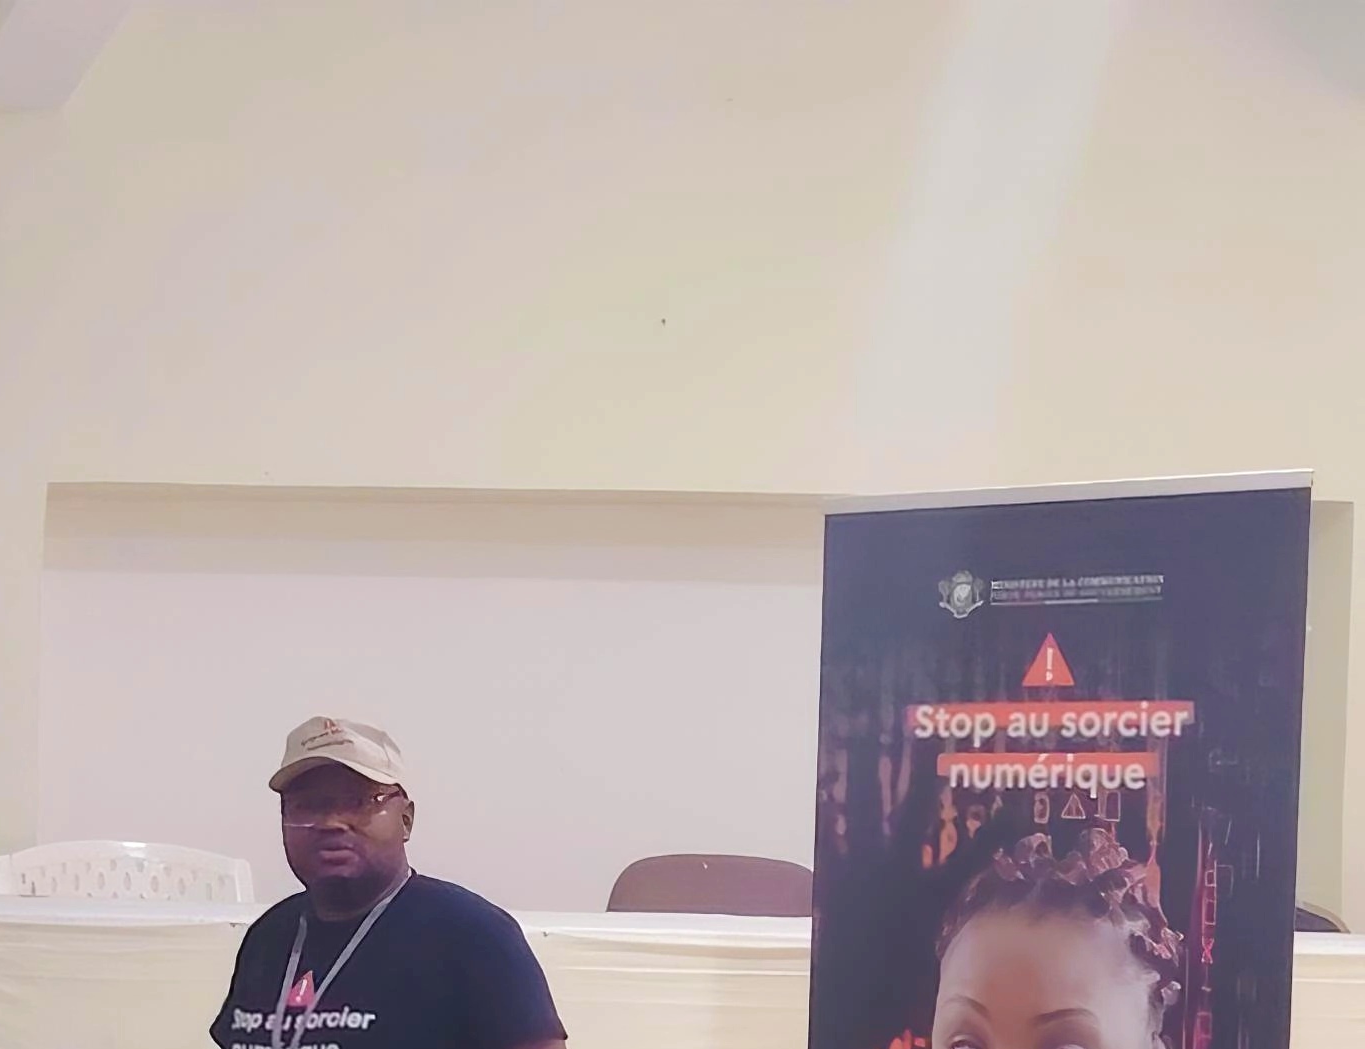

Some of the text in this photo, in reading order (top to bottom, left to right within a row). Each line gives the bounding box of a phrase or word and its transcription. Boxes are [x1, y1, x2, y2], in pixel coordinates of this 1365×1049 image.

[914, 702, 1189, 748] Stop au sorcier
[949, 754, 1146, 799] numérique
